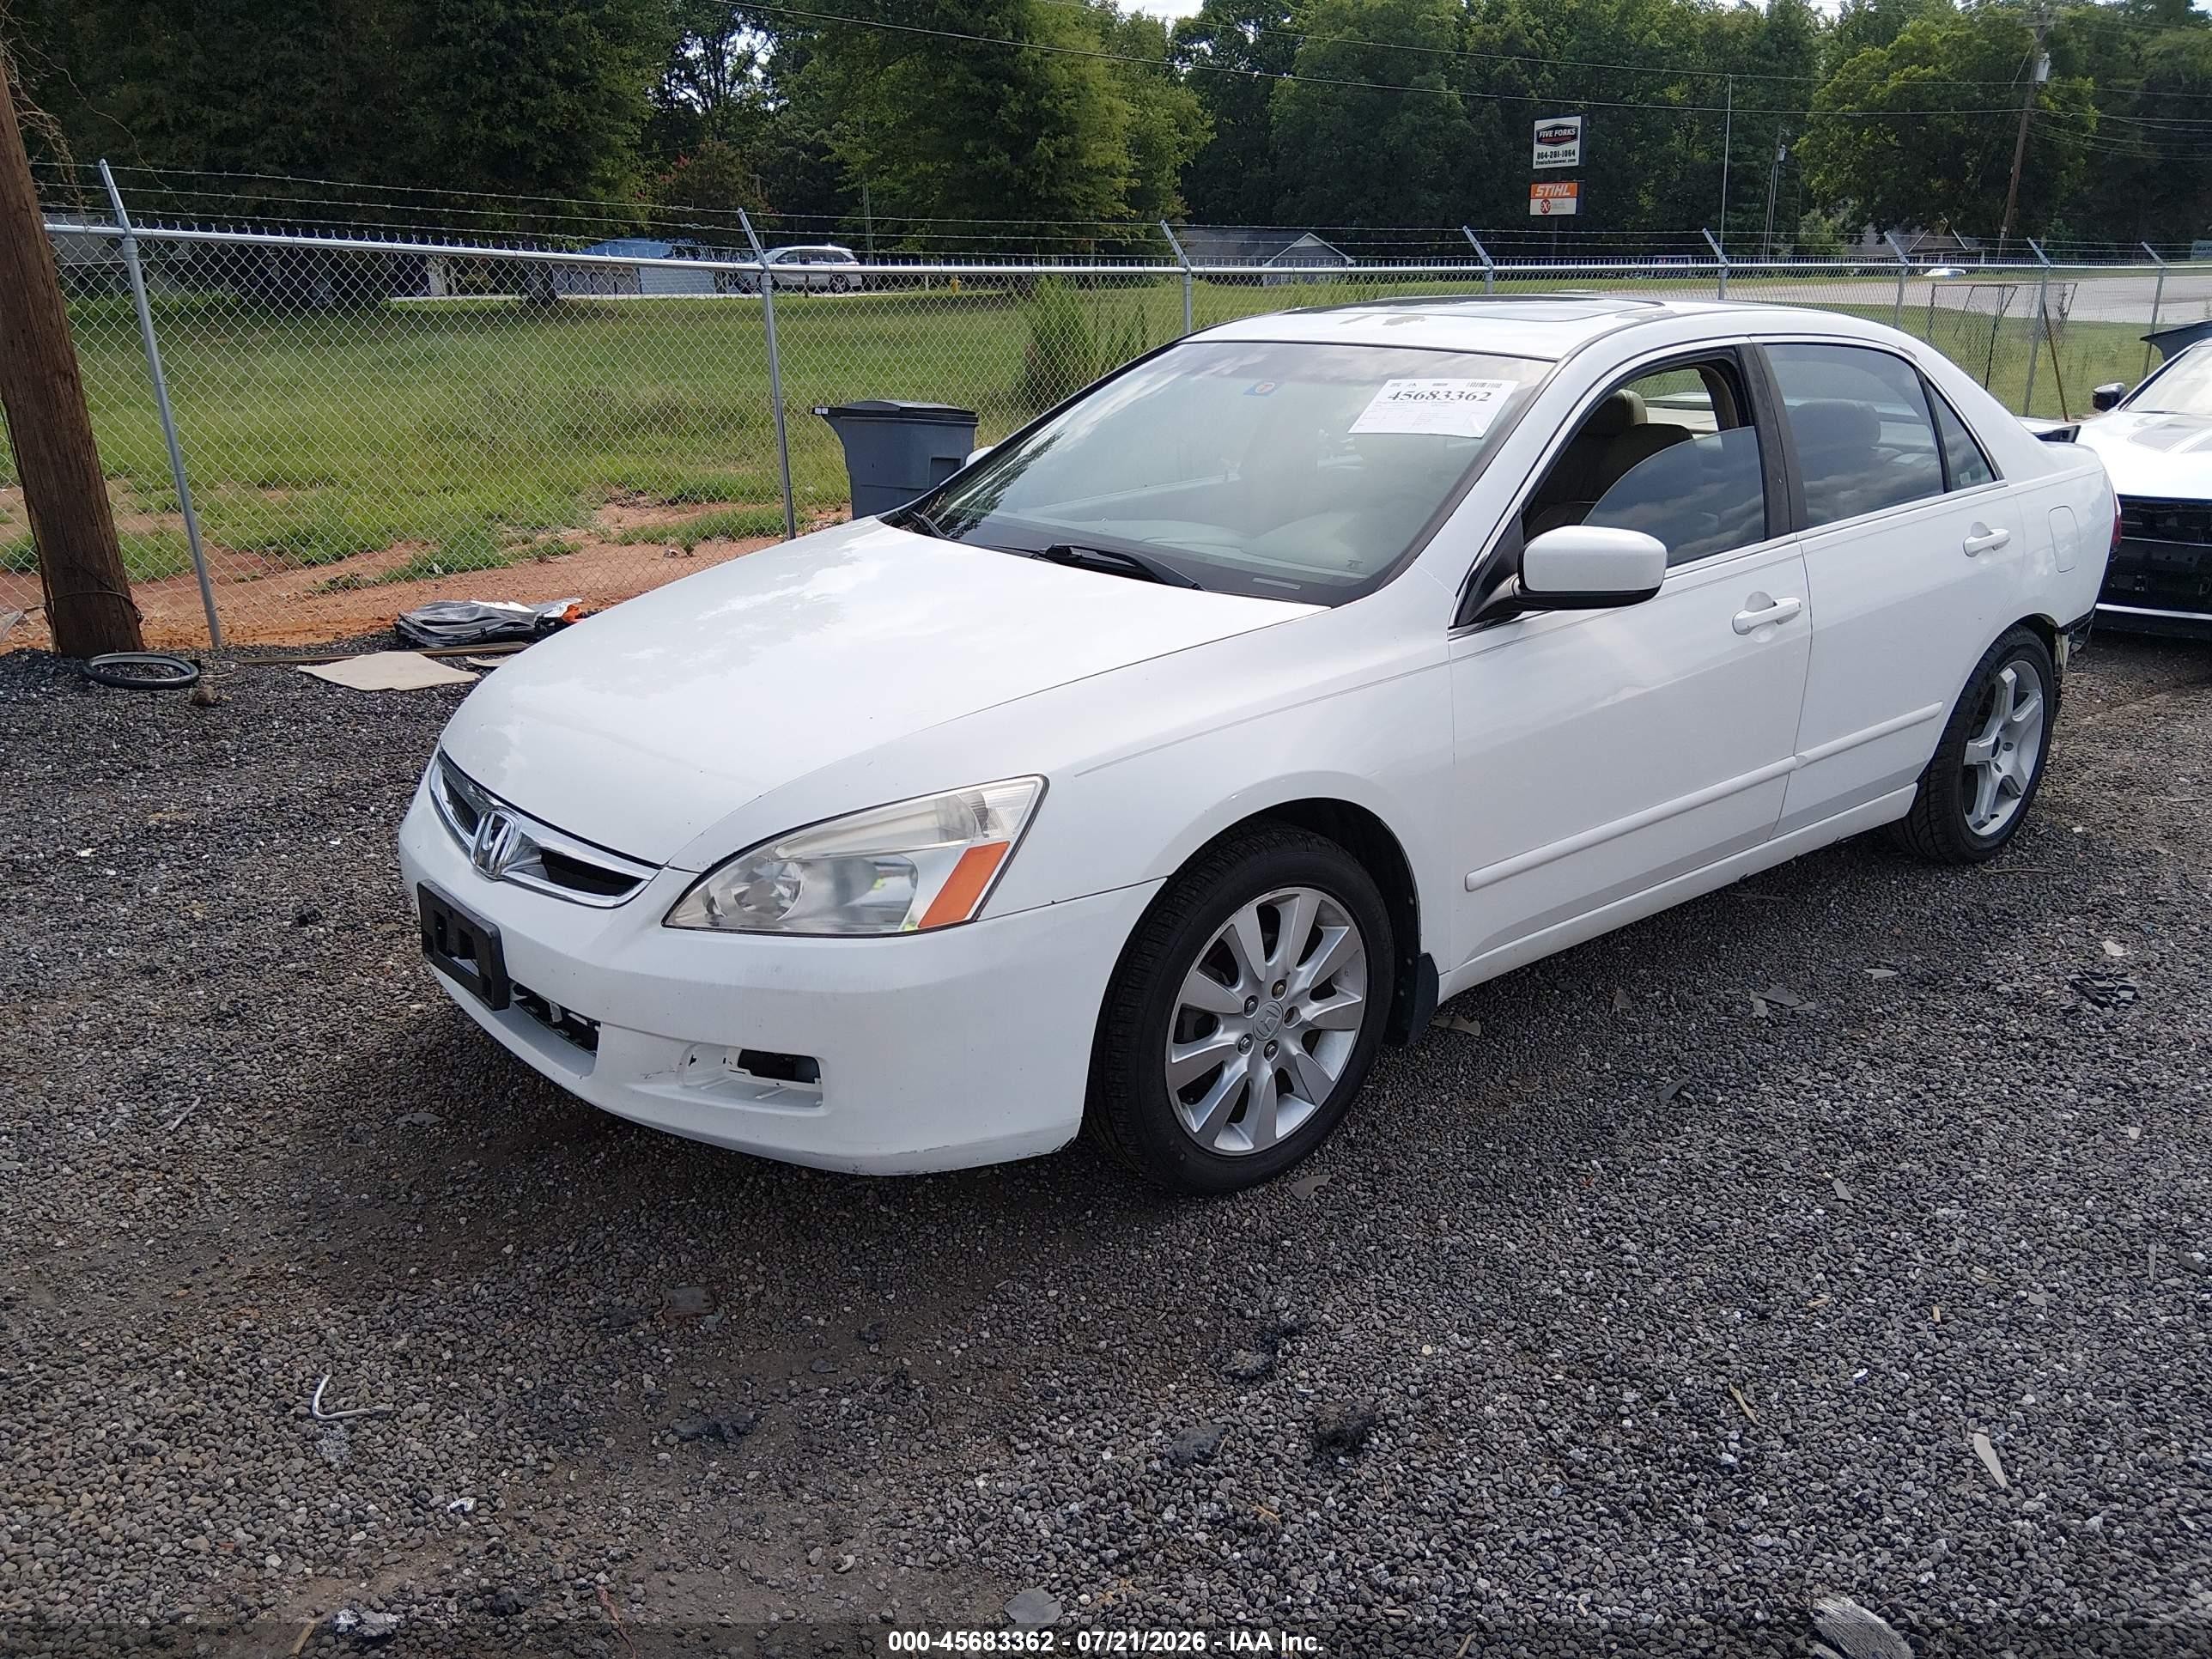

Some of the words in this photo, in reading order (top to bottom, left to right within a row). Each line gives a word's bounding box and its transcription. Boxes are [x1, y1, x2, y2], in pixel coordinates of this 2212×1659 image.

[1539, 130, 1553, 138] FIVE
[1554, 128, 1576, 137] FORKS
[1534, 185, 1571, 197] STIHL
[1387, 390, 1492, 402] 45683362
